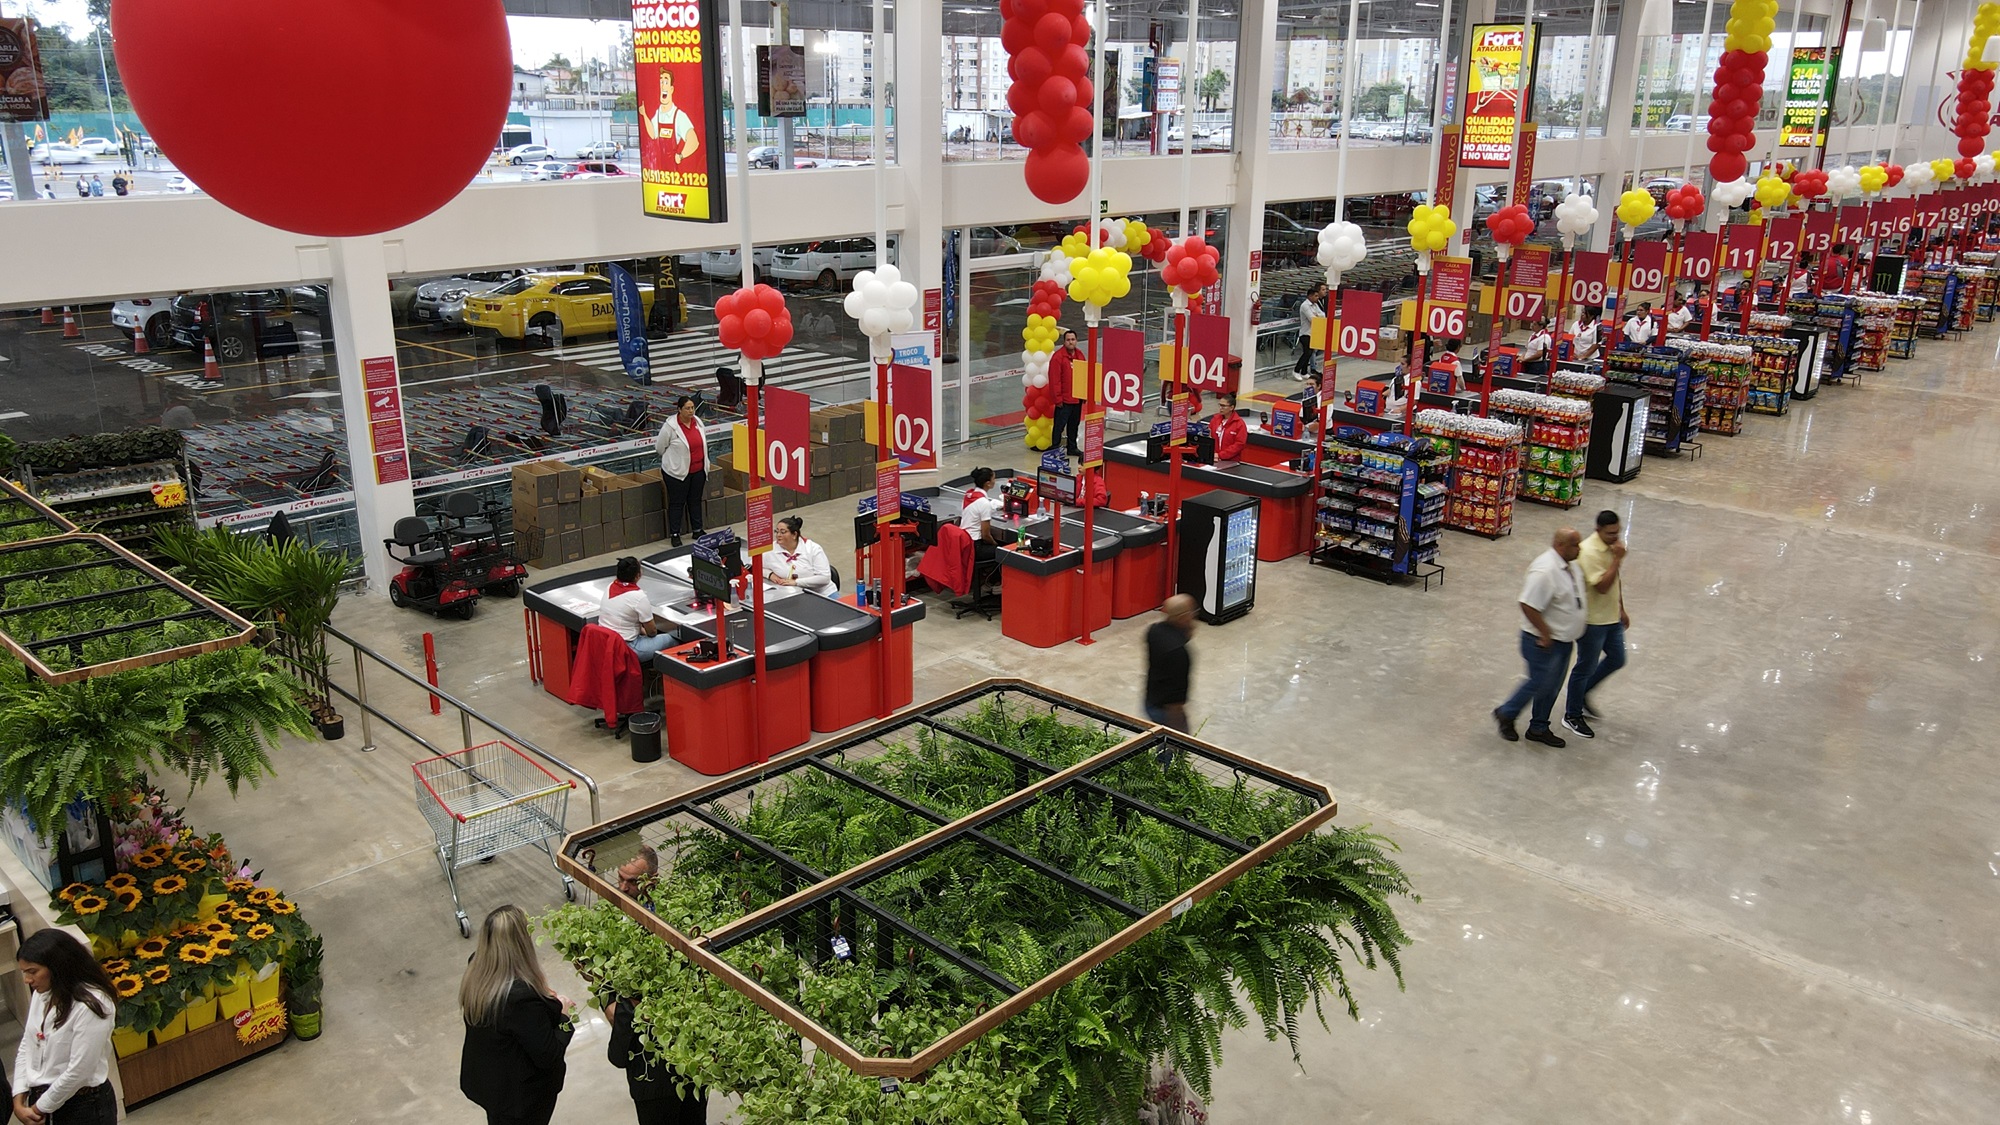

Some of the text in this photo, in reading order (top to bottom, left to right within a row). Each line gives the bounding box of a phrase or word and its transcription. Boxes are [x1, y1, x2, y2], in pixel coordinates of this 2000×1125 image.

[632, 4, 700, 29] NEGÓCIO
[634, 30, 700, 45] COM O NOSSO
[1484, 31, 1521, 46] Fort
[635, 47, 702, 63] TELEVENDAS
[1792, 80, 1826, 88] FRUTA
[1784, 100, 1829, 108] ECONOMA
[1466, 115, 1515, 125] QUALIDAD
[1466, 125, 1514, 135] VARIEDAD
[1463, 143, 1512, 152] NO ATACAD
[1464, 135, 1512, 144] E ECONOMI
[1462, 151, 1511, 161] E NO VAREJ
[1520, 133, 1534, 204] XCLUSIVO
[658, 191, 684, 208] Fort
[656, 206, 686, 214] ATACADISTA
[1940, 207, 1960, 221] 18
[1961, 202, 1982, 216] 19
[1917, 211, 1939, 227] 17
[1838, 226, 1863, 244] 14
[1869, 221, 1892, 237] 15
[1769, 240, 1795, 260] 12
[1806, 233, 1830, 251] 13
[1729, 248, 1755, 268] 11
[1683, 257, 1711, 278] 10
[1631, 267, 1662, 290] 09
[1572, 279, 1604, 304] 08
[1508, 292, 1543, 318] 07
[1429, 307, 1464, 335] 06
[1340, 326, 1377, 356] 05
[899, 348, 918, 357] TROCO
[1189, 353, 1225, 388] 04
[1104, 370, 1140, 407] 03
[894, 413, 930, 457] 02
[768, 440, 806, 487] 01
[313, 496, 345, 506] ATACADISTA
[240, 511, 274, 520] ATACADISTA
